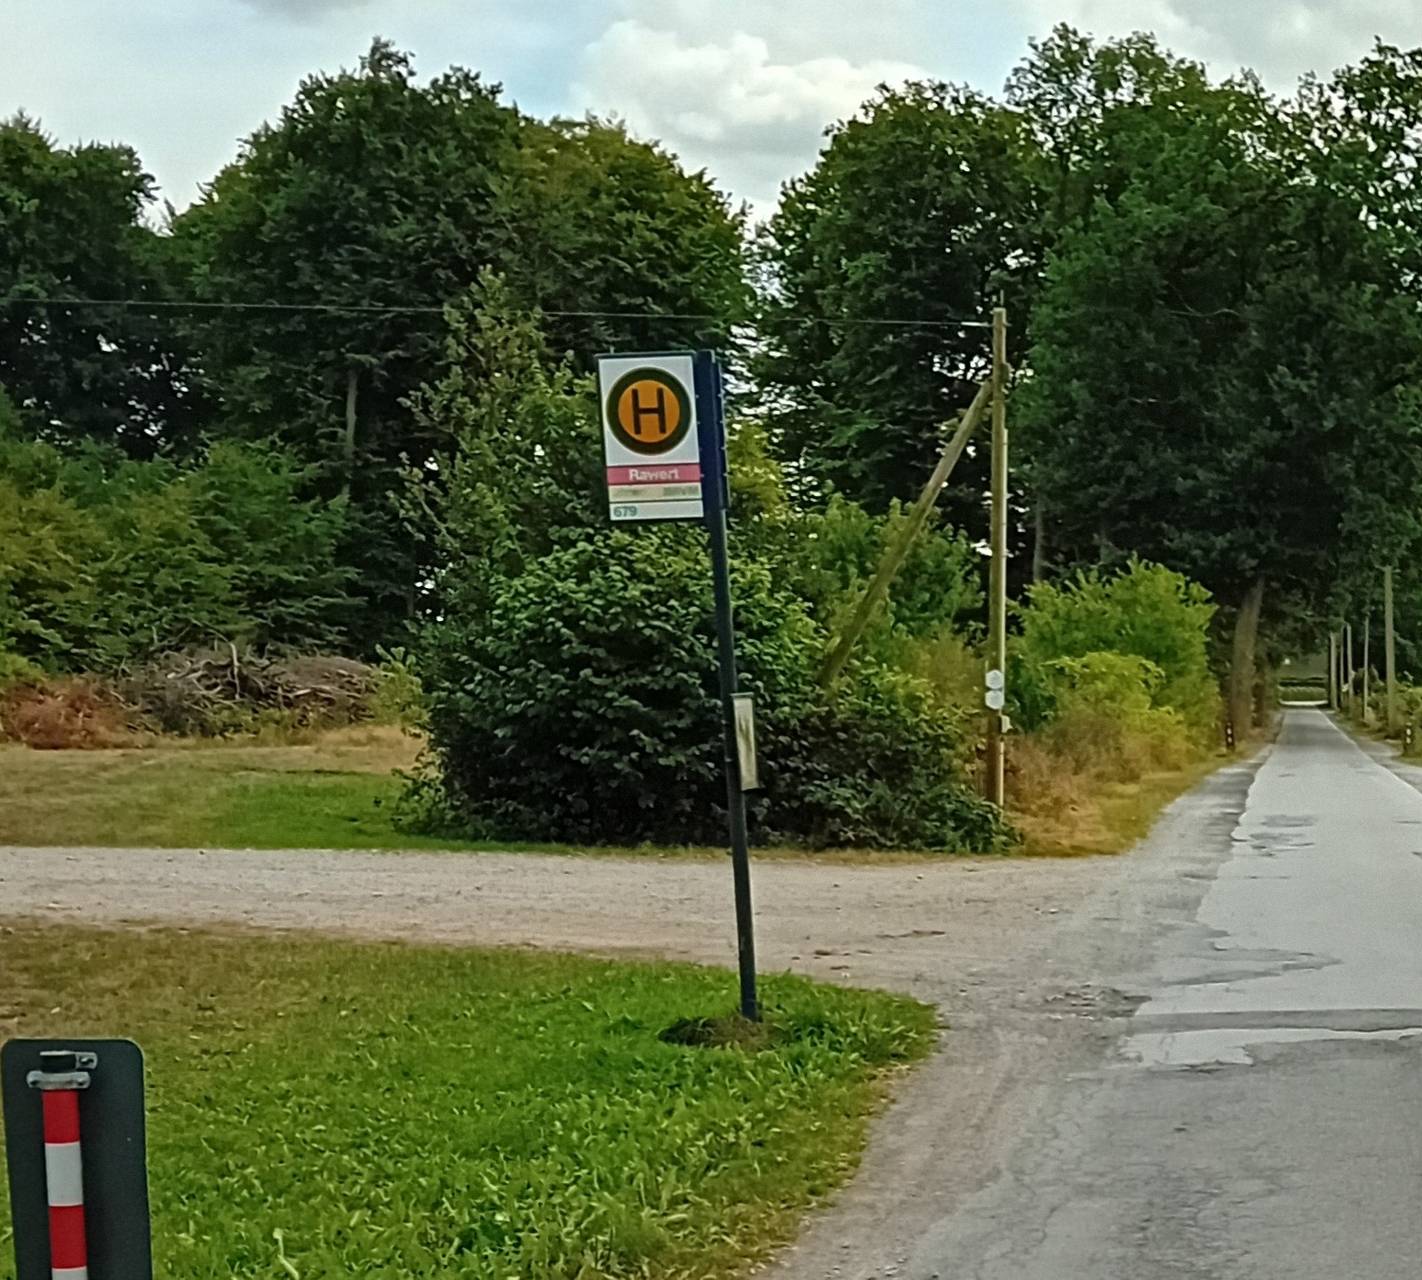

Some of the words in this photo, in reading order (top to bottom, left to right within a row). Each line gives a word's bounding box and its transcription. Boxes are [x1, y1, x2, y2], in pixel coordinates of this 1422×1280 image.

[631, 388, 667, 435] H
[628, 468, 681, 483] Rawert
[613, 505, 638, 518] 679
